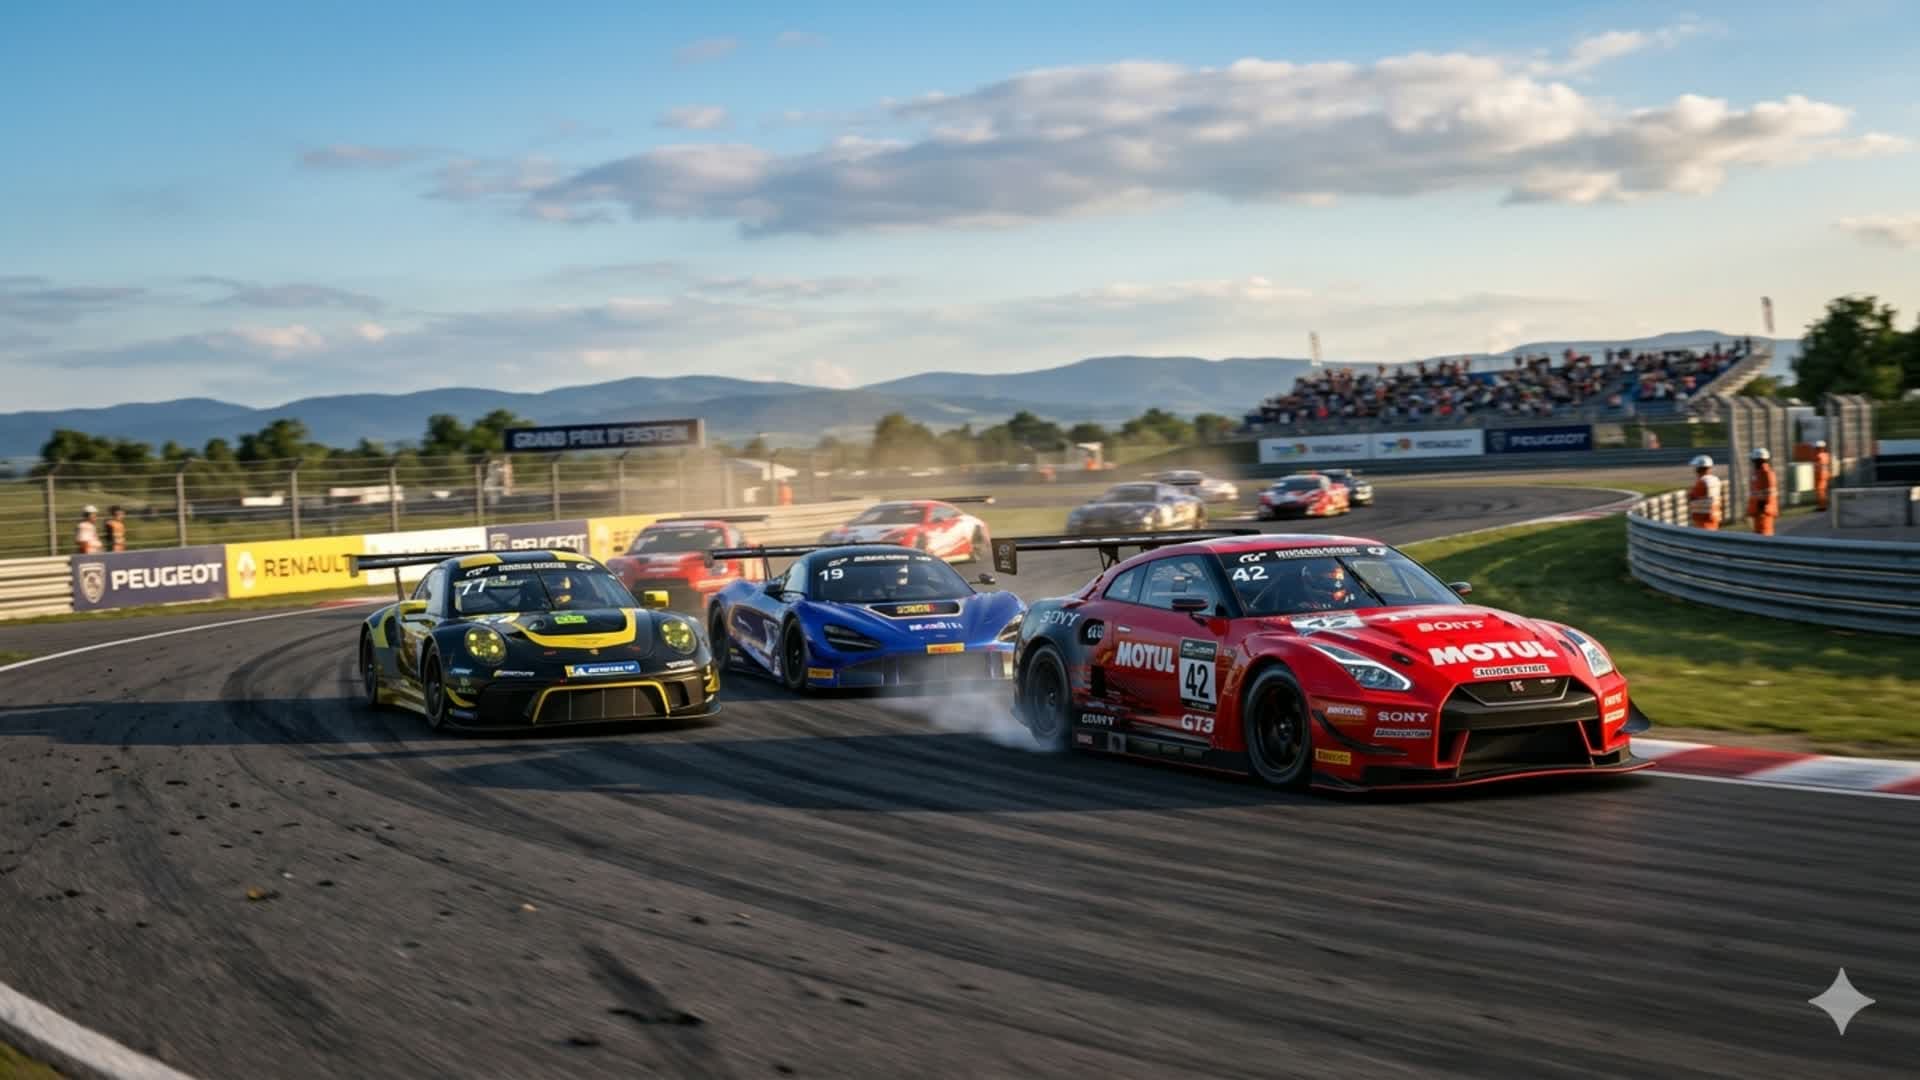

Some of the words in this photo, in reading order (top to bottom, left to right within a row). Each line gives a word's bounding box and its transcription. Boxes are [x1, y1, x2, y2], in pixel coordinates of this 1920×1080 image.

[111, 562, 222, 590] PEUGEOT
[818, 568, 844, 582] 19
[462, 578, 487, 596] 77
[1115, 641, 1176, 673] MOTUL
[1428, 640, 1560, 666] MOTUL
[1185, 663, 1209, 699] 42
[1181, 714, 1216, 734] GT3
[1377, 711, 1429, 723] SONY
